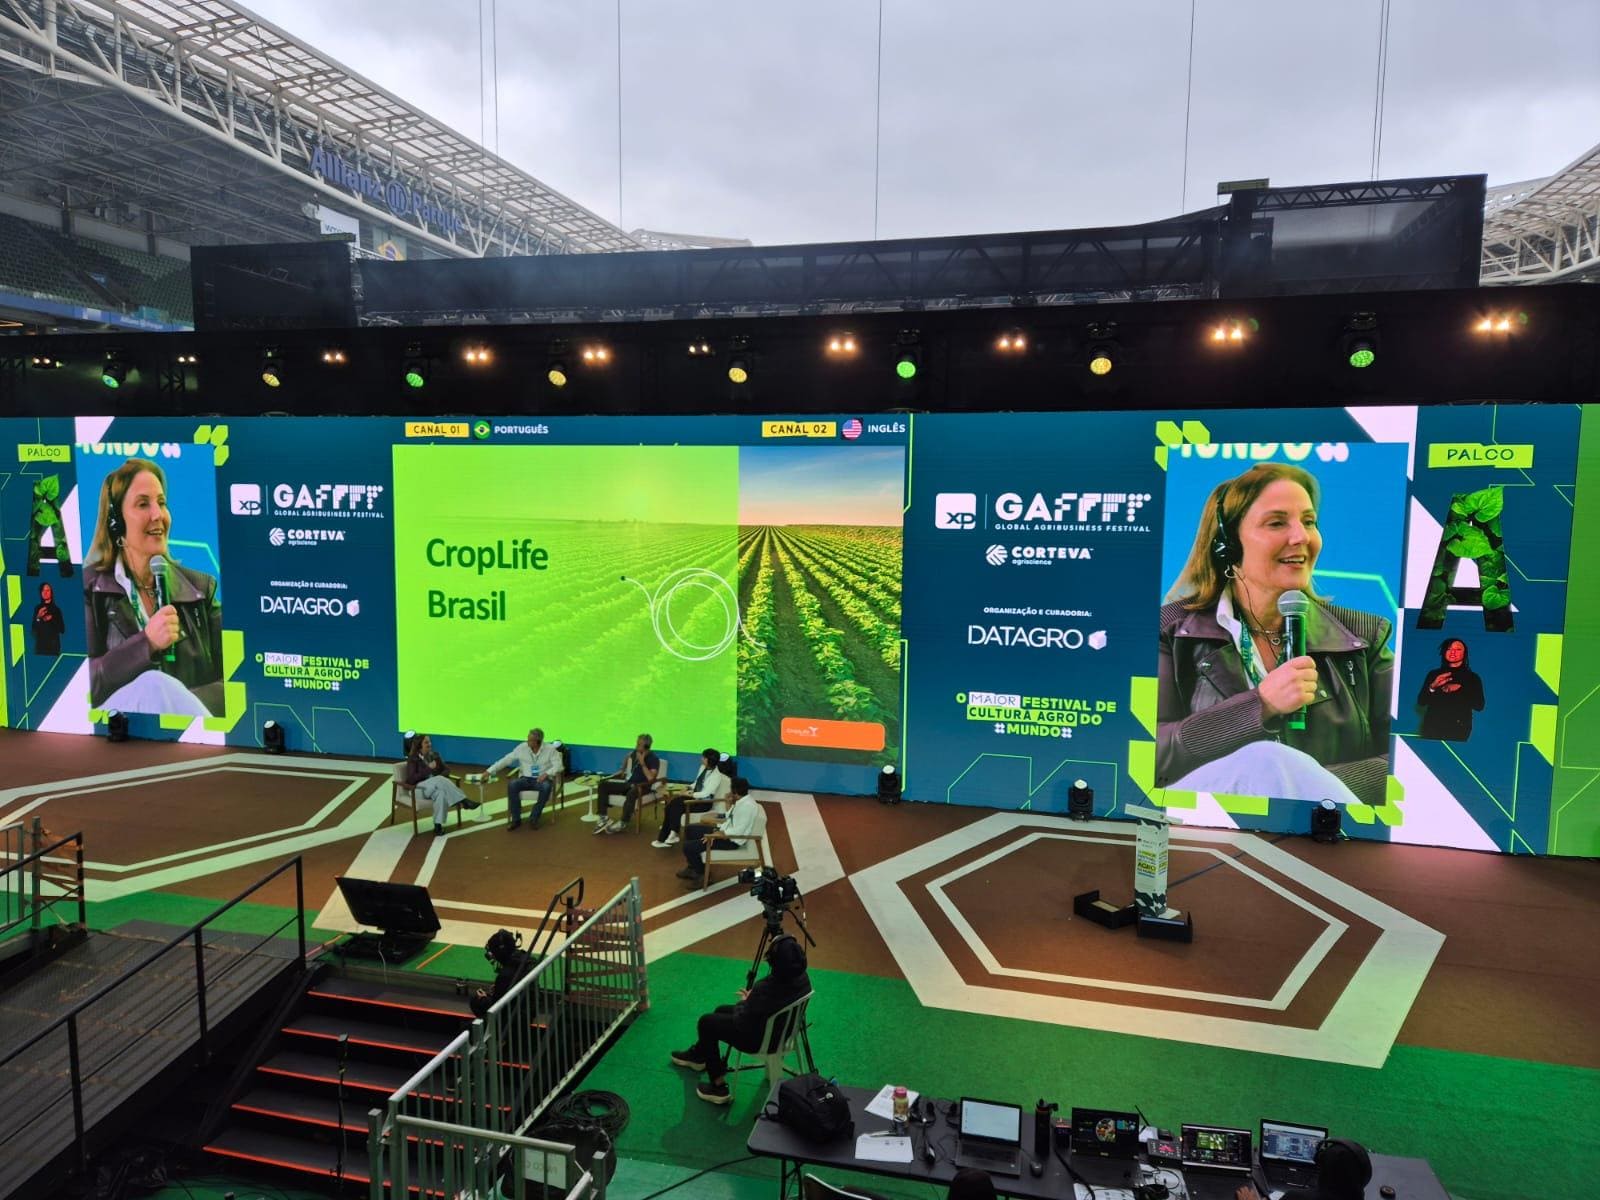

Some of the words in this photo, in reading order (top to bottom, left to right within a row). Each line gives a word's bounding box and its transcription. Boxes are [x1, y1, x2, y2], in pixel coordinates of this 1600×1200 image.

[309, 146, 384, 200] Allianz
[411, 191, 466, 234] Parque
[413, 425, 447, 434] CANAL
[450, 425, 460, 434] 01
[494, 423, 549, 434] PORTUGUÊS
[770, 424, 809, 434] CANAL
[813, 424, 828, 433] 02
[868, 422, 906, 433] INGLÊS
[27, 448, 61, 457] PALCO
[1447, 449, 1514, 460] PALCO
[1034, 524, 1102, 532] AGRIBUSINESS
[287, 529, 345, 541] CORTEVA
[426, 538, 549, 575] CropLife
[1012, 546, 1092, 559] CORTEVA
[270, 580, 309, 589] ORGANIZAÇÃO
[260, 595, 344, 616] DATAGRO
[428, 590, 506, 621] Brasil
[984, 606, 1037, 616] ORGANIZAÇÃO
[1045, 609, 1092, 617] CURADORIA:
[967, 625, 1084, 649] DATAGRO
[255, 653, 264, 663] O
[266, 654, 299, 663] MAIOR
[302, 655, 352, 668] FESTIVAL
[354, 659, 370, 669] DE
[265, 664, 310, 676] CULTURA
[313, 668, 342, 678] AGRO
[344, 670, 360, 679] DO
[293, 679, 332, 691] MUNDO
[956, 692, 967, 704] O
[971, 694, 1017, 705] MAIOR
[1022, 696, 1092, 711] FESTIVAL
[1096, 701, 1117, 713] DE
[969, 707, 1032, 721] CULTURA
[1037, 712, 1076, 723] AGRO
[1080, 714, 1102, 725] DO
[1006, 724, 1061, 737] MUNDO
